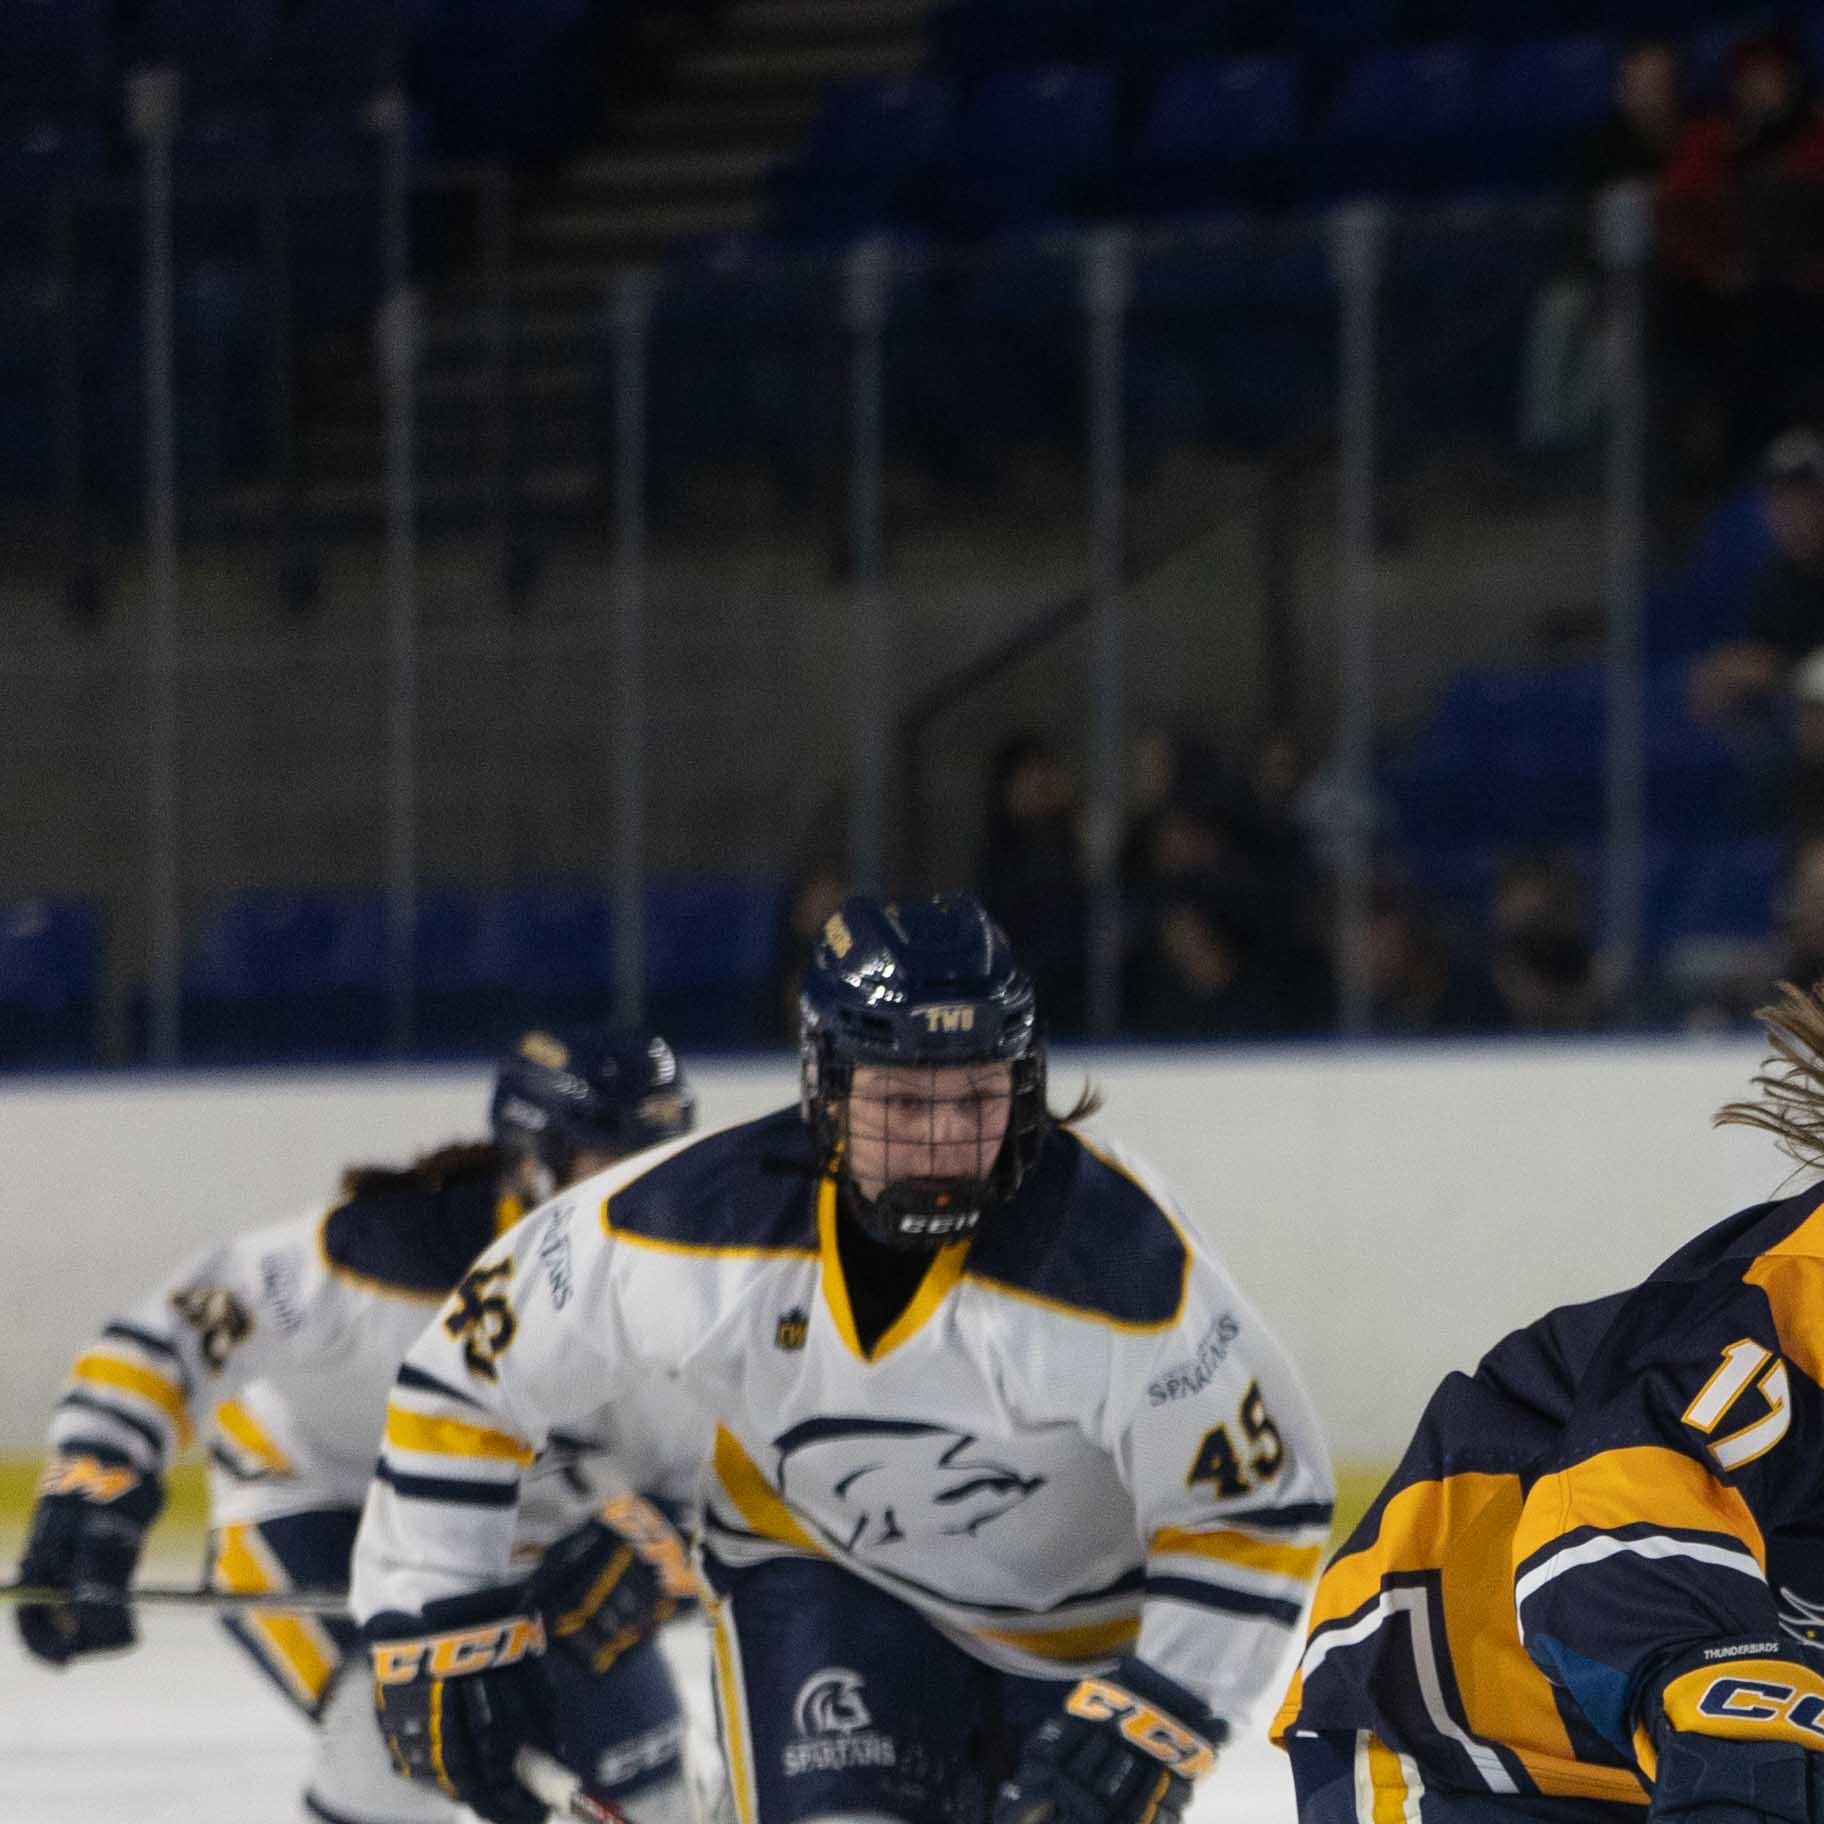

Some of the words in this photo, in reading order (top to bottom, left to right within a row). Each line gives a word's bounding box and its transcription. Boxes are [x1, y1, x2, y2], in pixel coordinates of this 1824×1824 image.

[926, 1006, 975, 1033] TWU
[1185, 1376, 1283, 1500] 45
[1680, 1336, 1792, 1473] 17
[1703, 1642, 1780, 1660] THUNDERBIRDS
